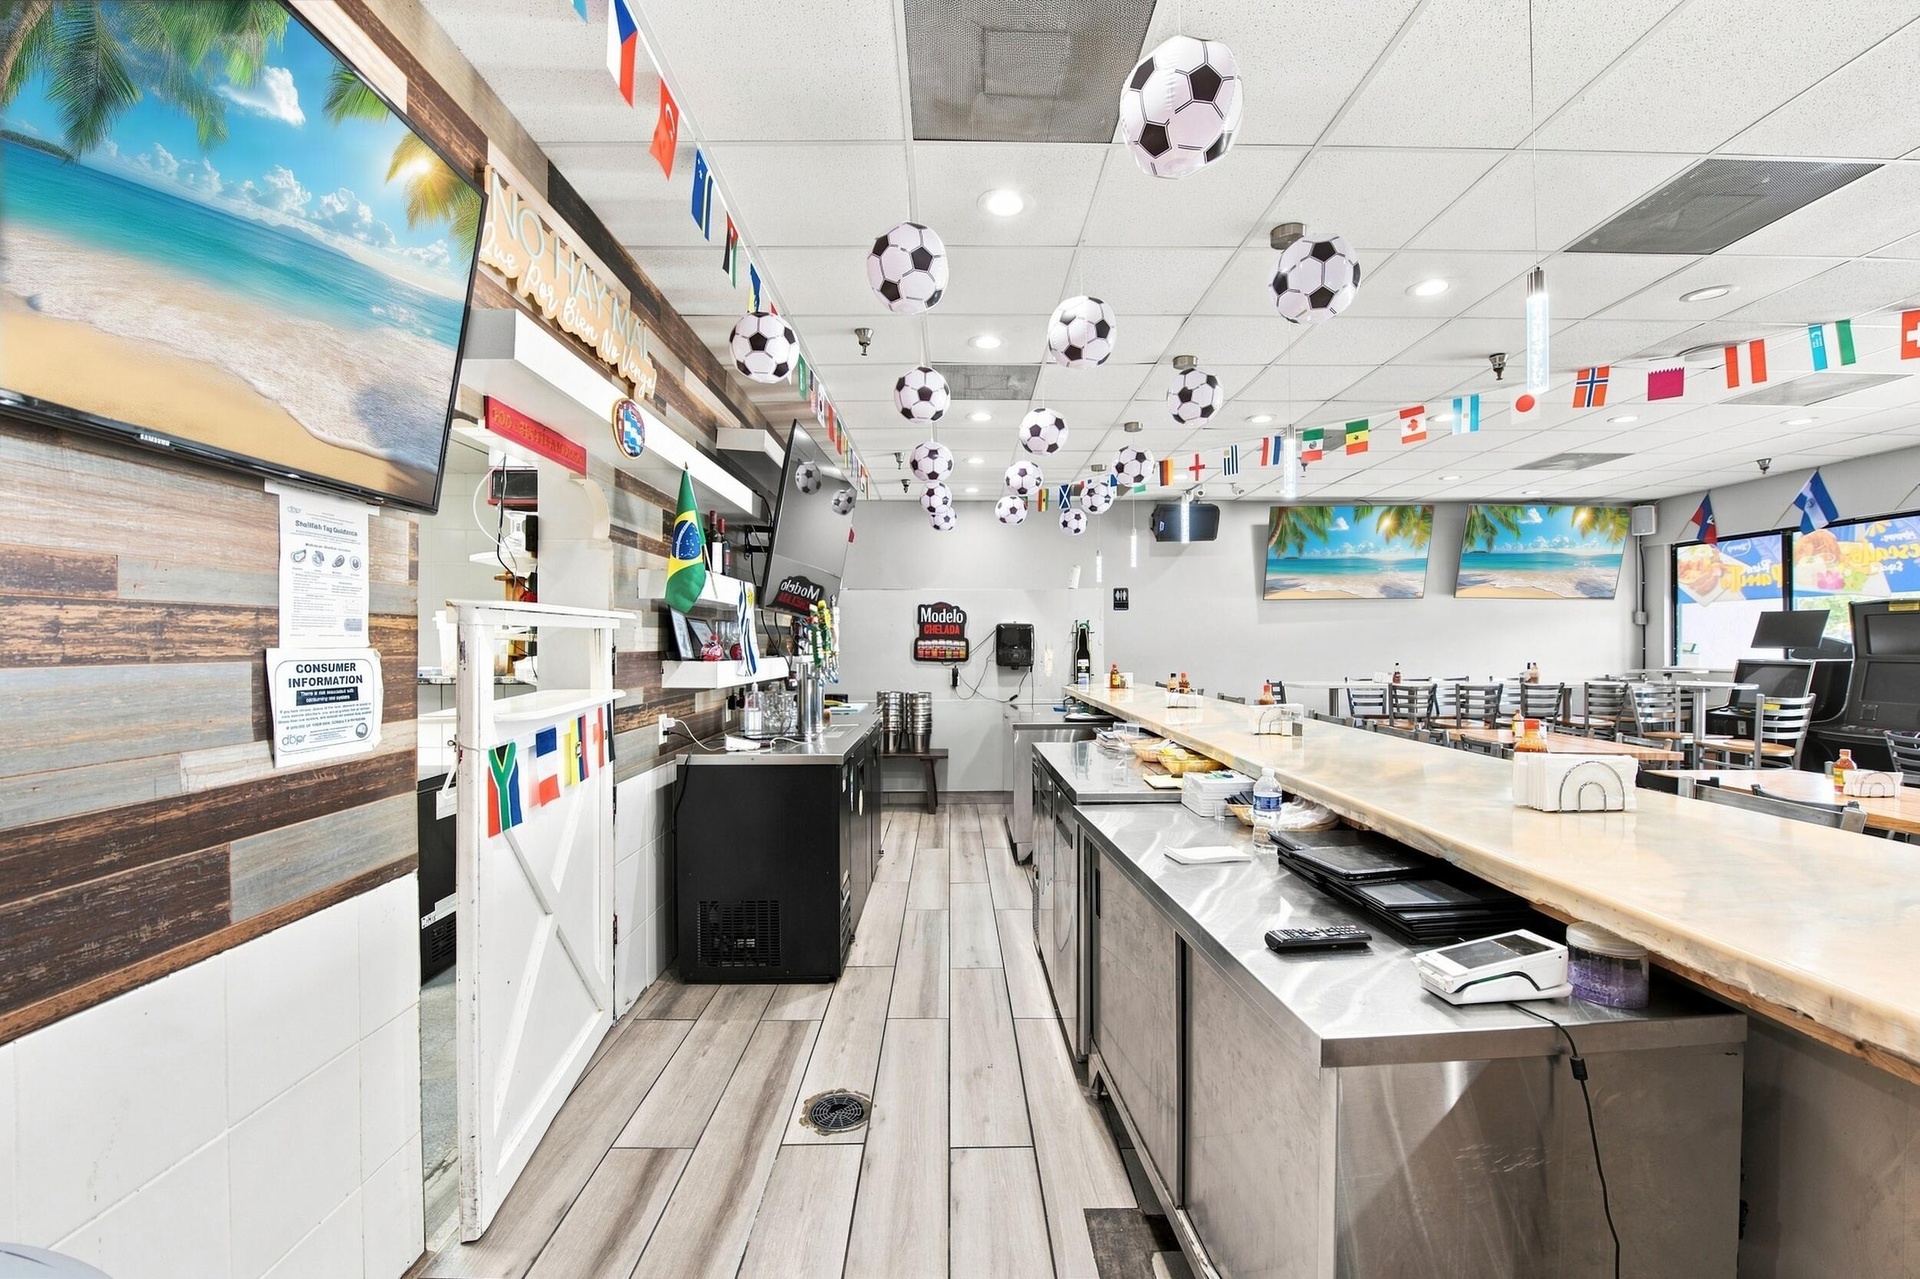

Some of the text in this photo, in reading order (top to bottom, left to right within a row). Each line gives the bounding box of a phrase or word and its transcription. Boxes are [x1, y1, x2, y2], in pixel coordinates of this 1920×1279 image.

[491, 172, 649, 359] NO HAY MAL
[524, 260, 558, 312] Por
[562, 296, 599, 341] Bien
[601, 328, 620, 361] No
[323, 525, 333, 534] Tag
[920, 607, 964, 624] Modelo
[924, 624, 960, 635] CHELADA
[296, 663, 356, 673] CONSUMER
[288, 675, 363, 688] INFORMATION
[282, 734, 306, 746] dbpr
